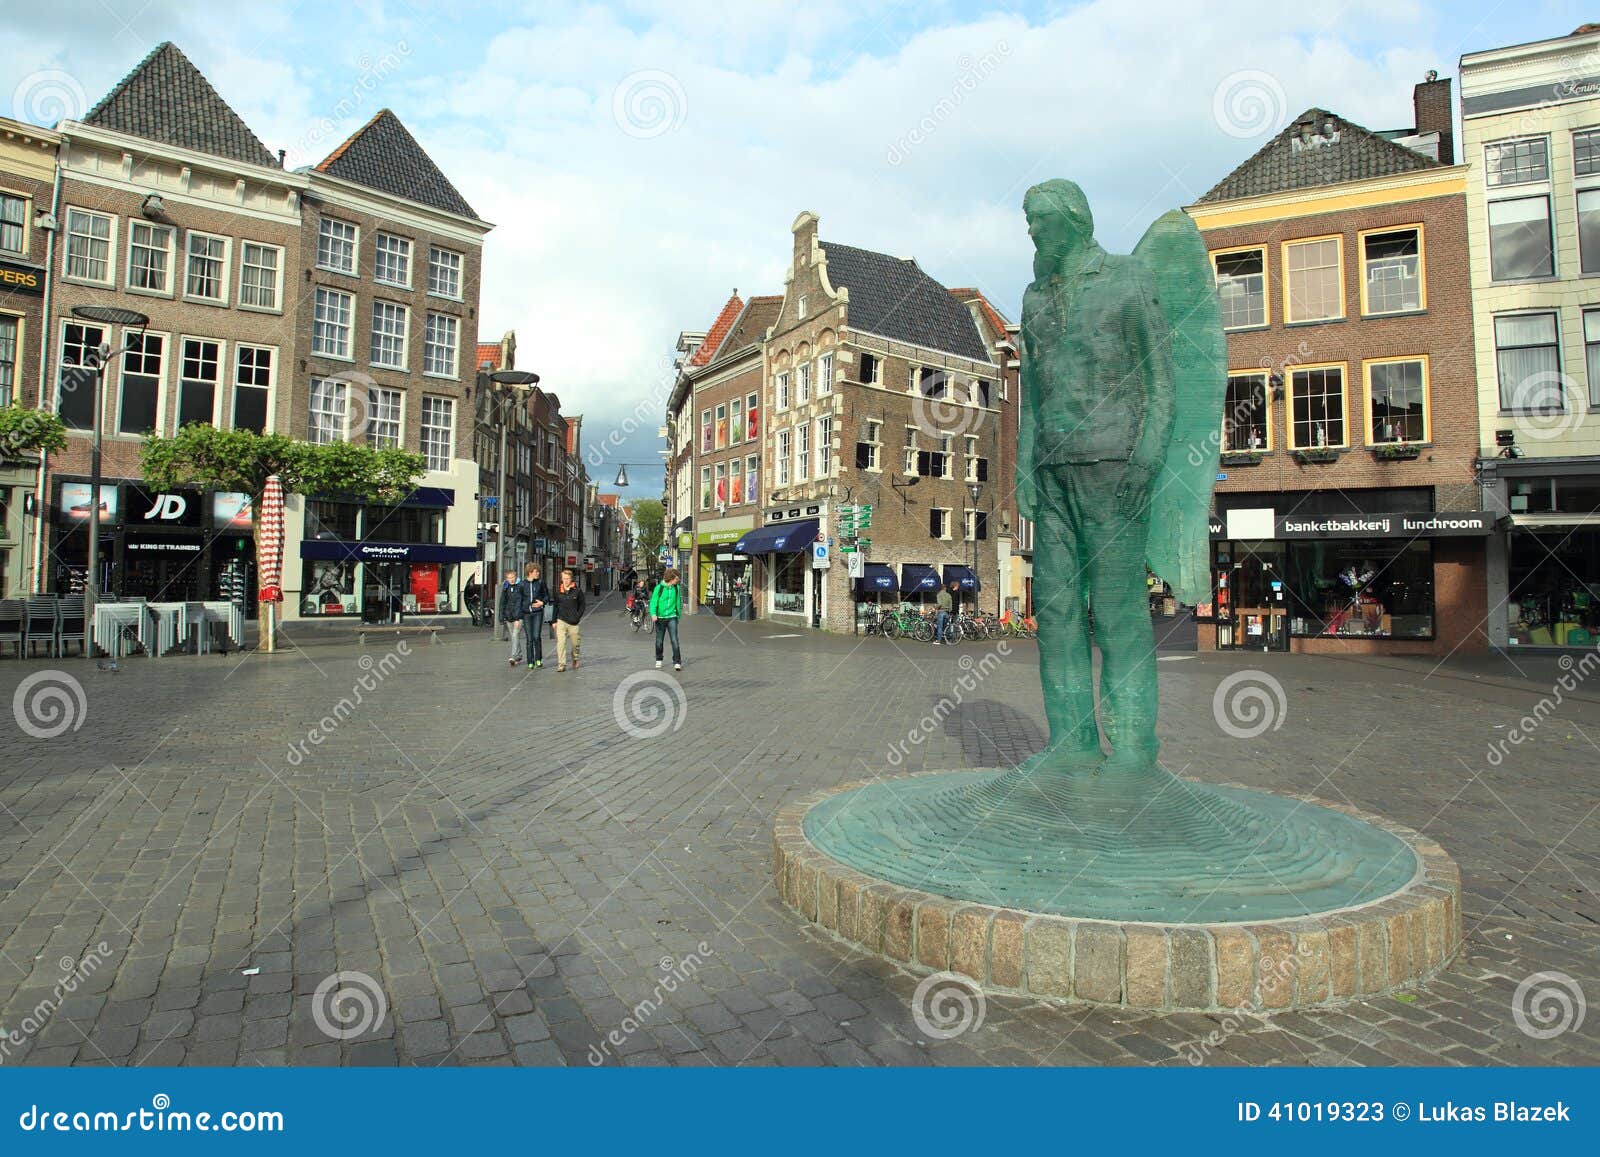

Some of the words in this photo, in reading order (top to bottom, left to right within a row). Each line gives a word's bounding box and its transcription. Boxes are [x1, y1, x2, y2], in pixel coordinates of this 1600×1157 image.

[144, 494, 186, 519] JD
[1285, 518, 1390, 533] banketbakkerij
[1403, 518, 1483, 530] lunchroom
